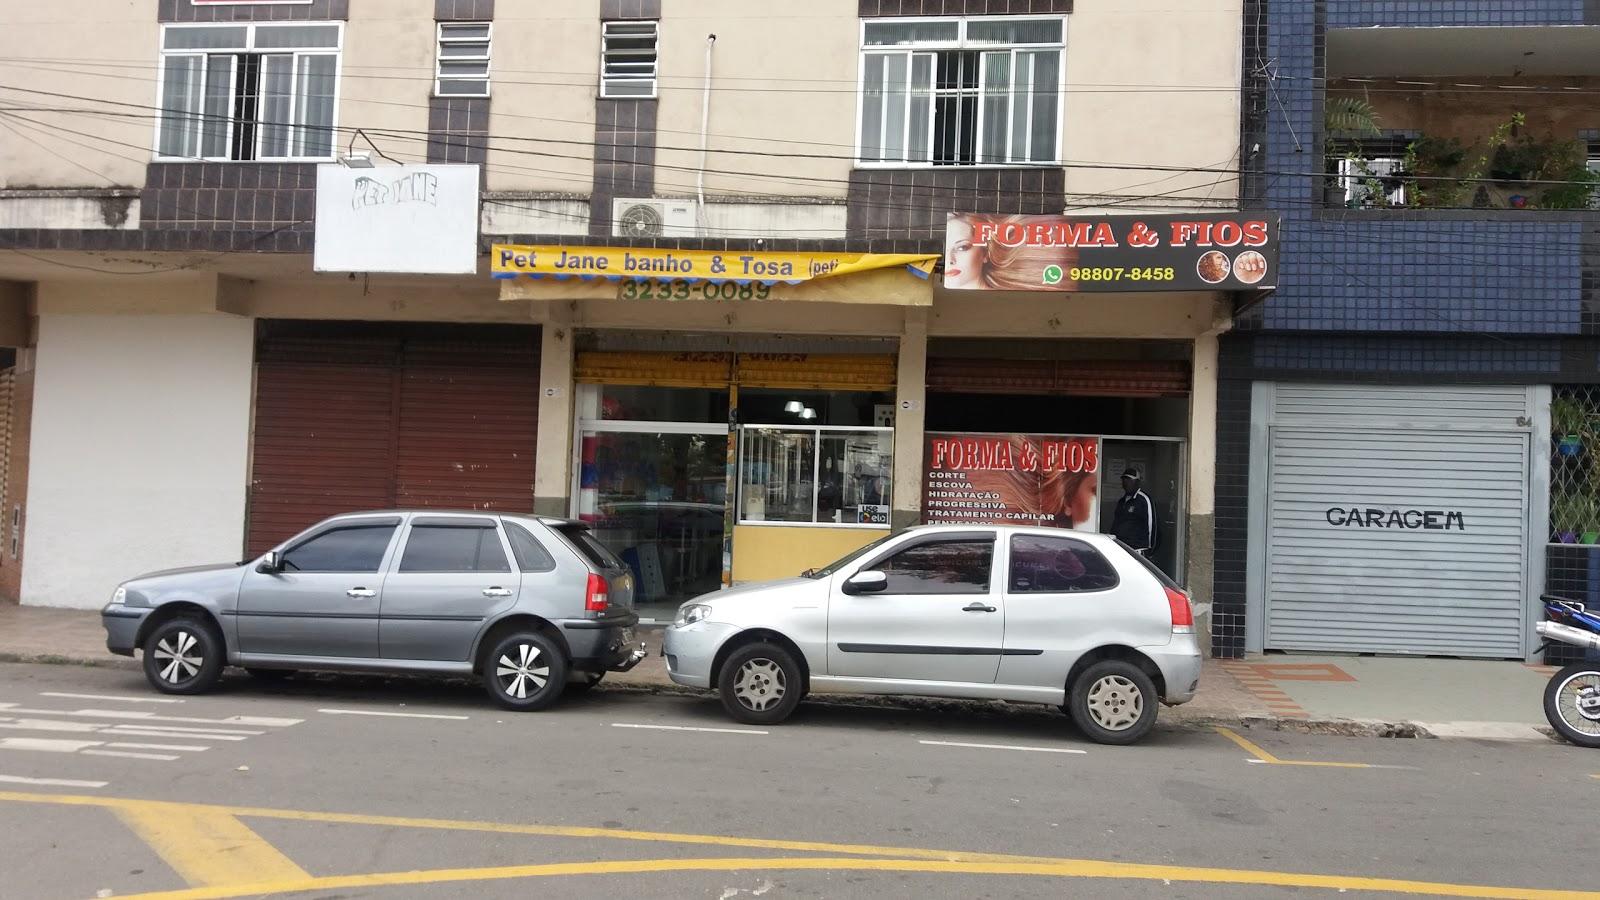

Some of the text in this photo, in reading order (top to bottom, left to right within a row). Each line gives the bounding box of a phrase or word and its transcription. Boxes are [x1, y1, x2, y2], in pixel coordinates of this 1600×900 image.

[972, 220, 1269, 249] FORMA & FIOS
[500, 249, 538, 268] Pet
[554, 250, 609, 270] Jane
[624, 252, 693, 273] banho
[710, 255, 727, 274] &
[739, 255, 793, 276] Tosa
[1069, 266, 1176, 282] 98807-8458
[622, 279, 771, 300] 3233-0089
[931, 437, 1015, 471] FORMA
[1018, 440, 1038, 473] &
[1042, 439, 1099, 474] FIOS
[928, 471, 967, 480] CORTE
[928, 480, 973, 490] ESCOVA
[928, 490, 1001, 500] HIDRATAÇÃO
[862, 505, 879, 513] use
[928, 500, 1007, 510] PROGRESSIVA
[927, 509, 1055, 521] TRATAMENTO CAPILAR
[1325, 507, 1465, 531] GARAGEM
